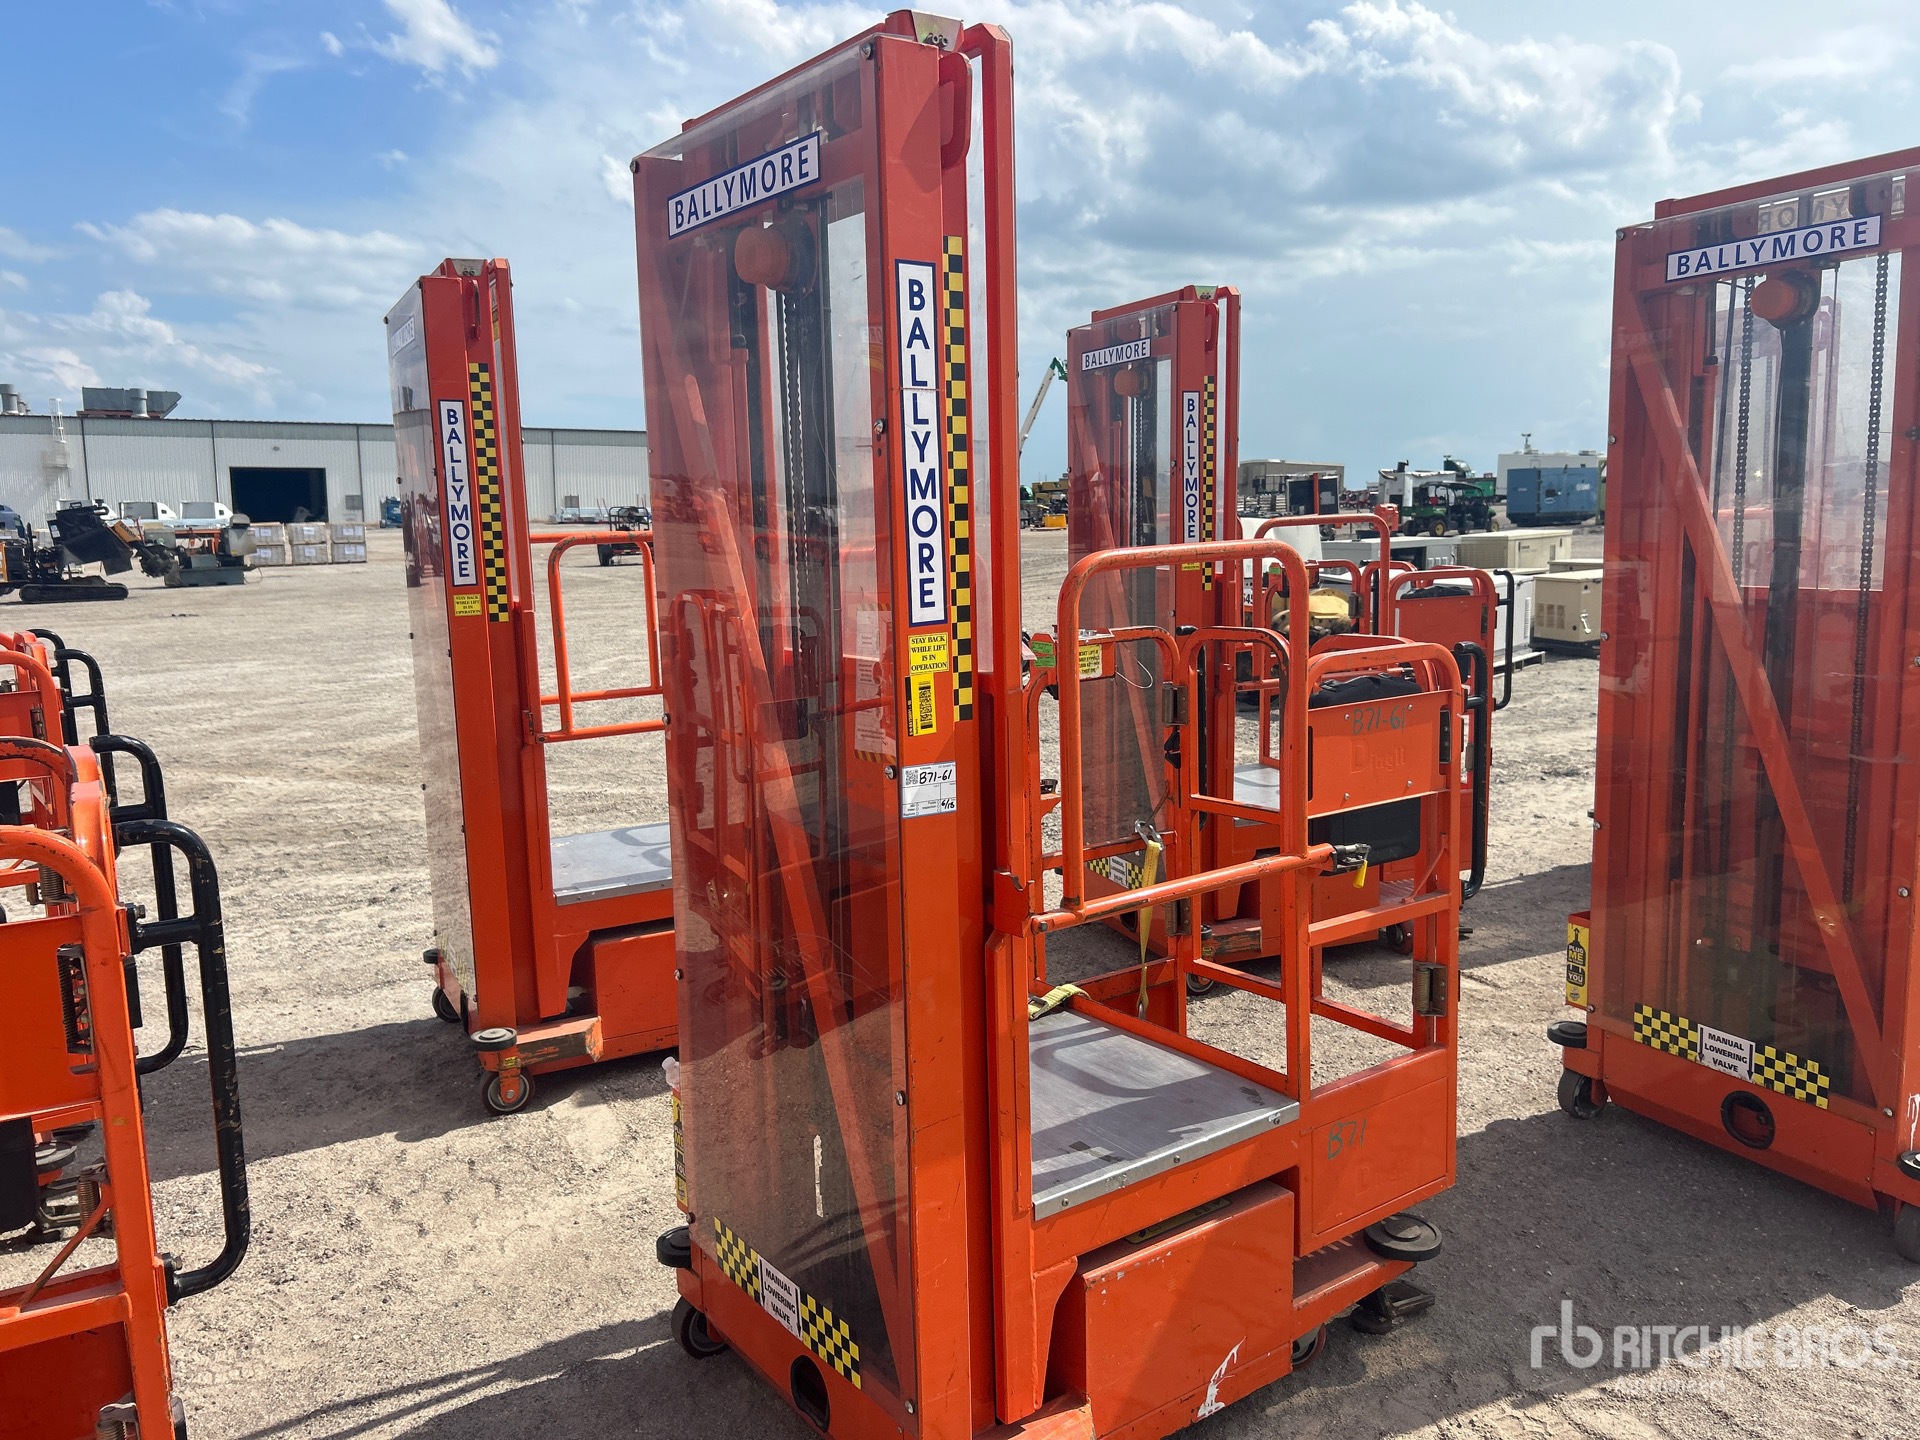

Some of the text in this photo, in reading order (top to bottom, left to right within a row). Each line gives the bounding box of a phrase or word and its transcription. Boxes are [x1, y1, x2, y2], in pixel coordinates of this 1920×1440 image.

[675, 143, 809, 229] BALLYMORE
[1676, 221, 1868, 276] BALLYMORE
[1085, 341, 1147, 368] BALLYMORE
[906, 279, 938, 608] BALLYMORE
[1185, 398, 1198, 538] BALLYMORE
[446, 408, 470, 577] BALLYMORE
[928, 635, 945, 643] BACK
[933, 644, 946, 652] LIFT
[911, 662, 947, 671] OPERATION
[1352, 704, 1406, 735] B71-61
[919, 769, 953, 785] B71-61
[1568, 945, 1584, 953] PLUG
[1569, 950, 1584, 961] ME
[1568, 972, 1583, 983] YOU
[1704, 1043, 1747, 1064] LOWERING
[1708, 1032, 1744, 1051] MANUAL
[1712, 1057, 1738, 1072] VALVE
[1327, 1118, 1367, 1160] B71
[765, 1267, 792, 1296] MANUAL
[764, 1281, 796, 1314] LOWERING
[771, 1301, 791, 1325] VALVE
